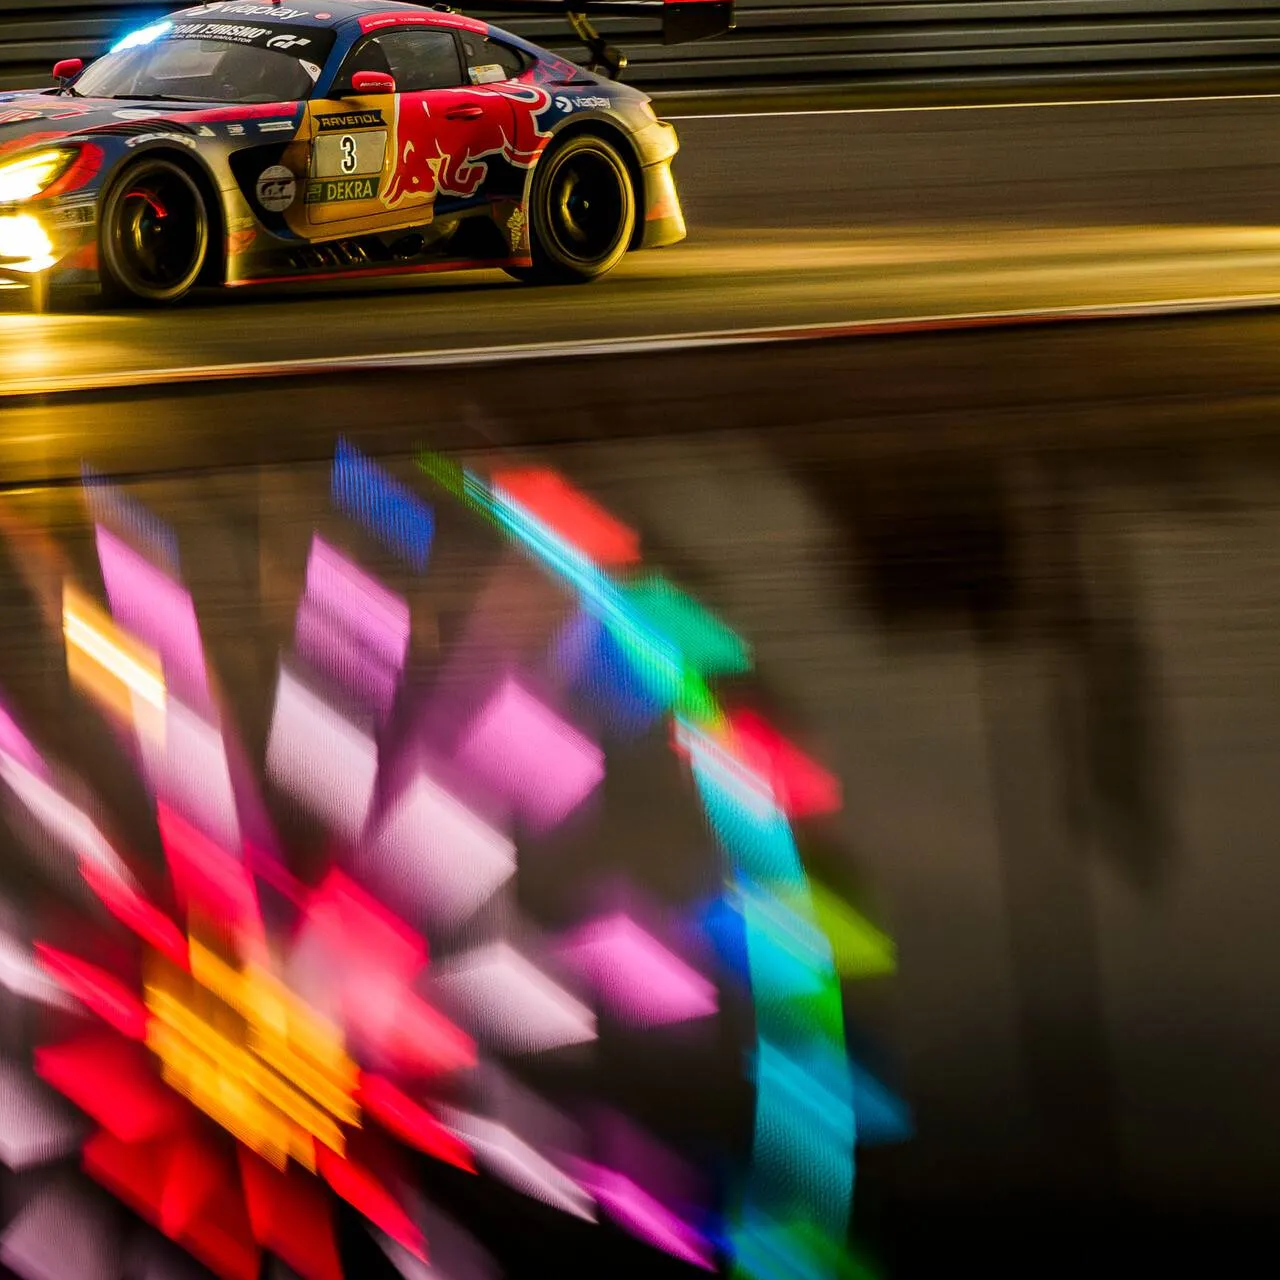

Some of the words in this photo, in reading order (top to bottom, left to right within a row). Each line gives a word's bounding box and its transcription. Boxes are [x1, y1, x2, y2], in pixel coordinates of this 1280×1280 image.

[220, 4, 310, 19] viaplay
[322, 114, 380, 127] RAVENOL
[340, 135, 357, 174] 3
[327, 180, 373, 200] DEKRA
